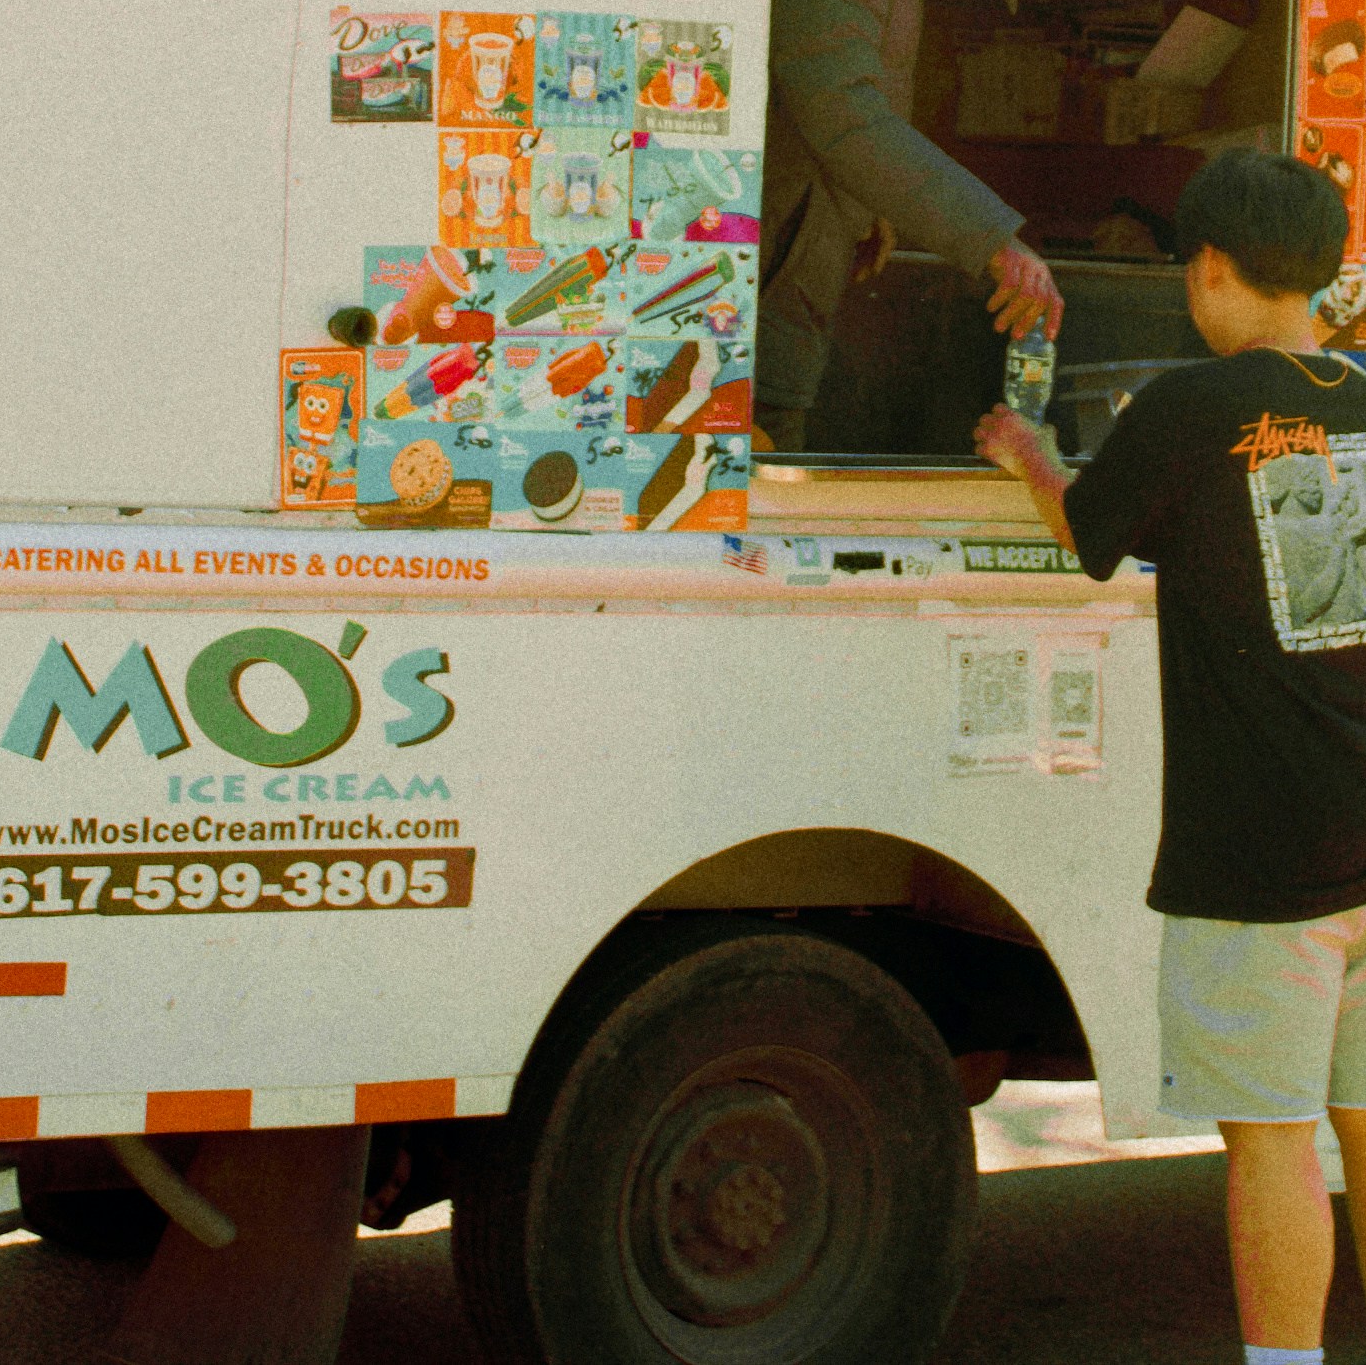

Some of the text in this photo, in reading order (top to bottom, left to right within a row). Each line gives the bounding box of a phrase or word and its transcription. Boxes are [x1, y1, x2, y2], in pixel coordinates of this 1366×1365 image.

[460, 110, 517, 123] MANGO
[133, 548, 184, 575] ALL
[193, 550, 298, 577] EVENTS
[305, 554, 326, 577] &
[336, 553, 490, 582] OCCASIONS
[906, 554, 933, 580] Pay
[966, 546, 993, 567] WE
[996, 546, 1059, 570] ACCEPT
[167, 772, 452, 804] ICE CREAM
